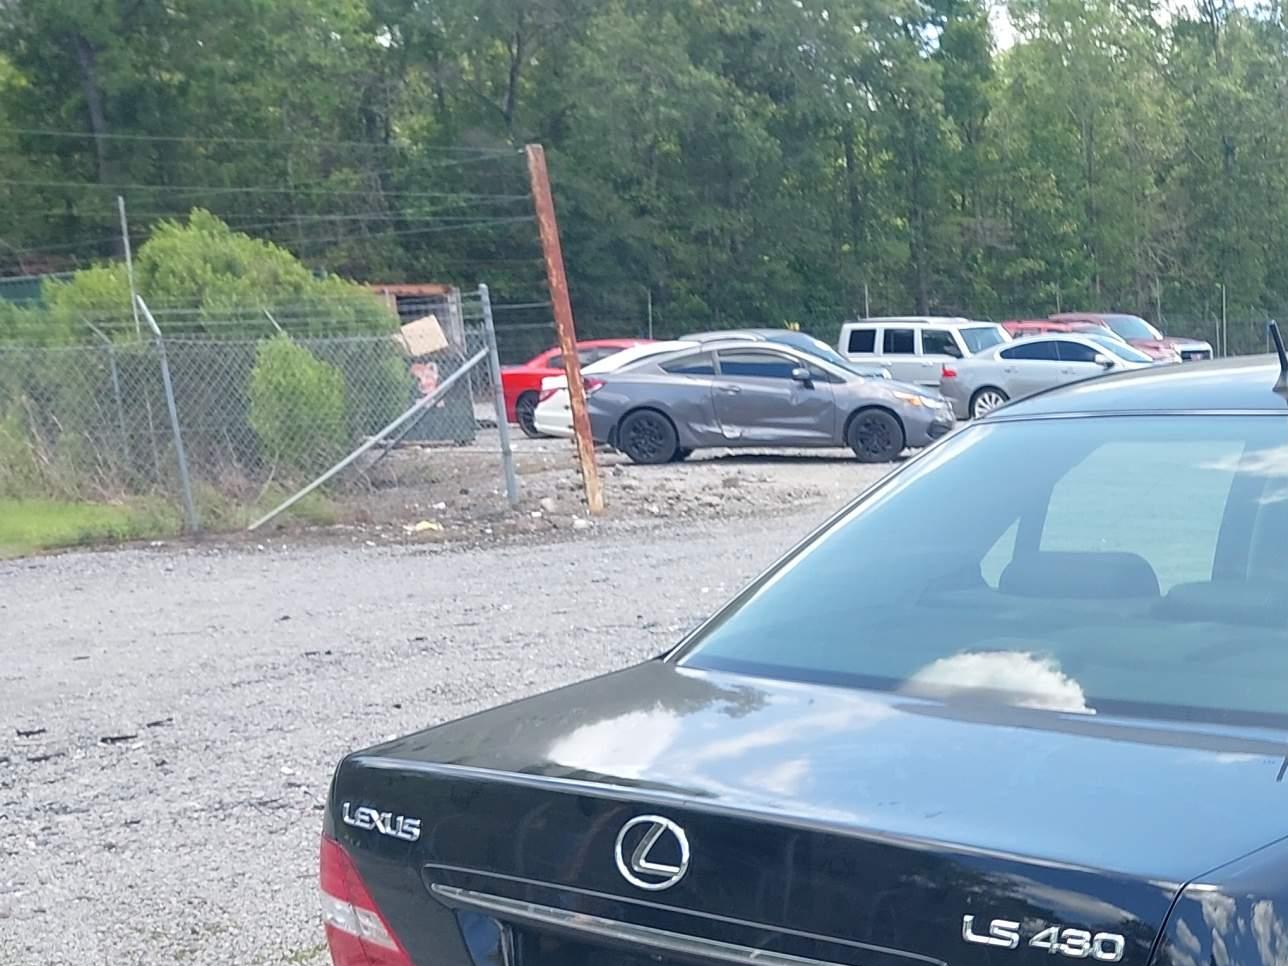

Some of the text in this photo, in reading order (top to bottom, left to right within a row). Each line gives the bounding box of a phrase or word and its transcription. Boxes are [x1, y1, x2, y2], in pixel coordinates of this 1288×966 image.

[342, 802, 421, 842] LEXUS
[962, 914, 1126, 963] LS 430
